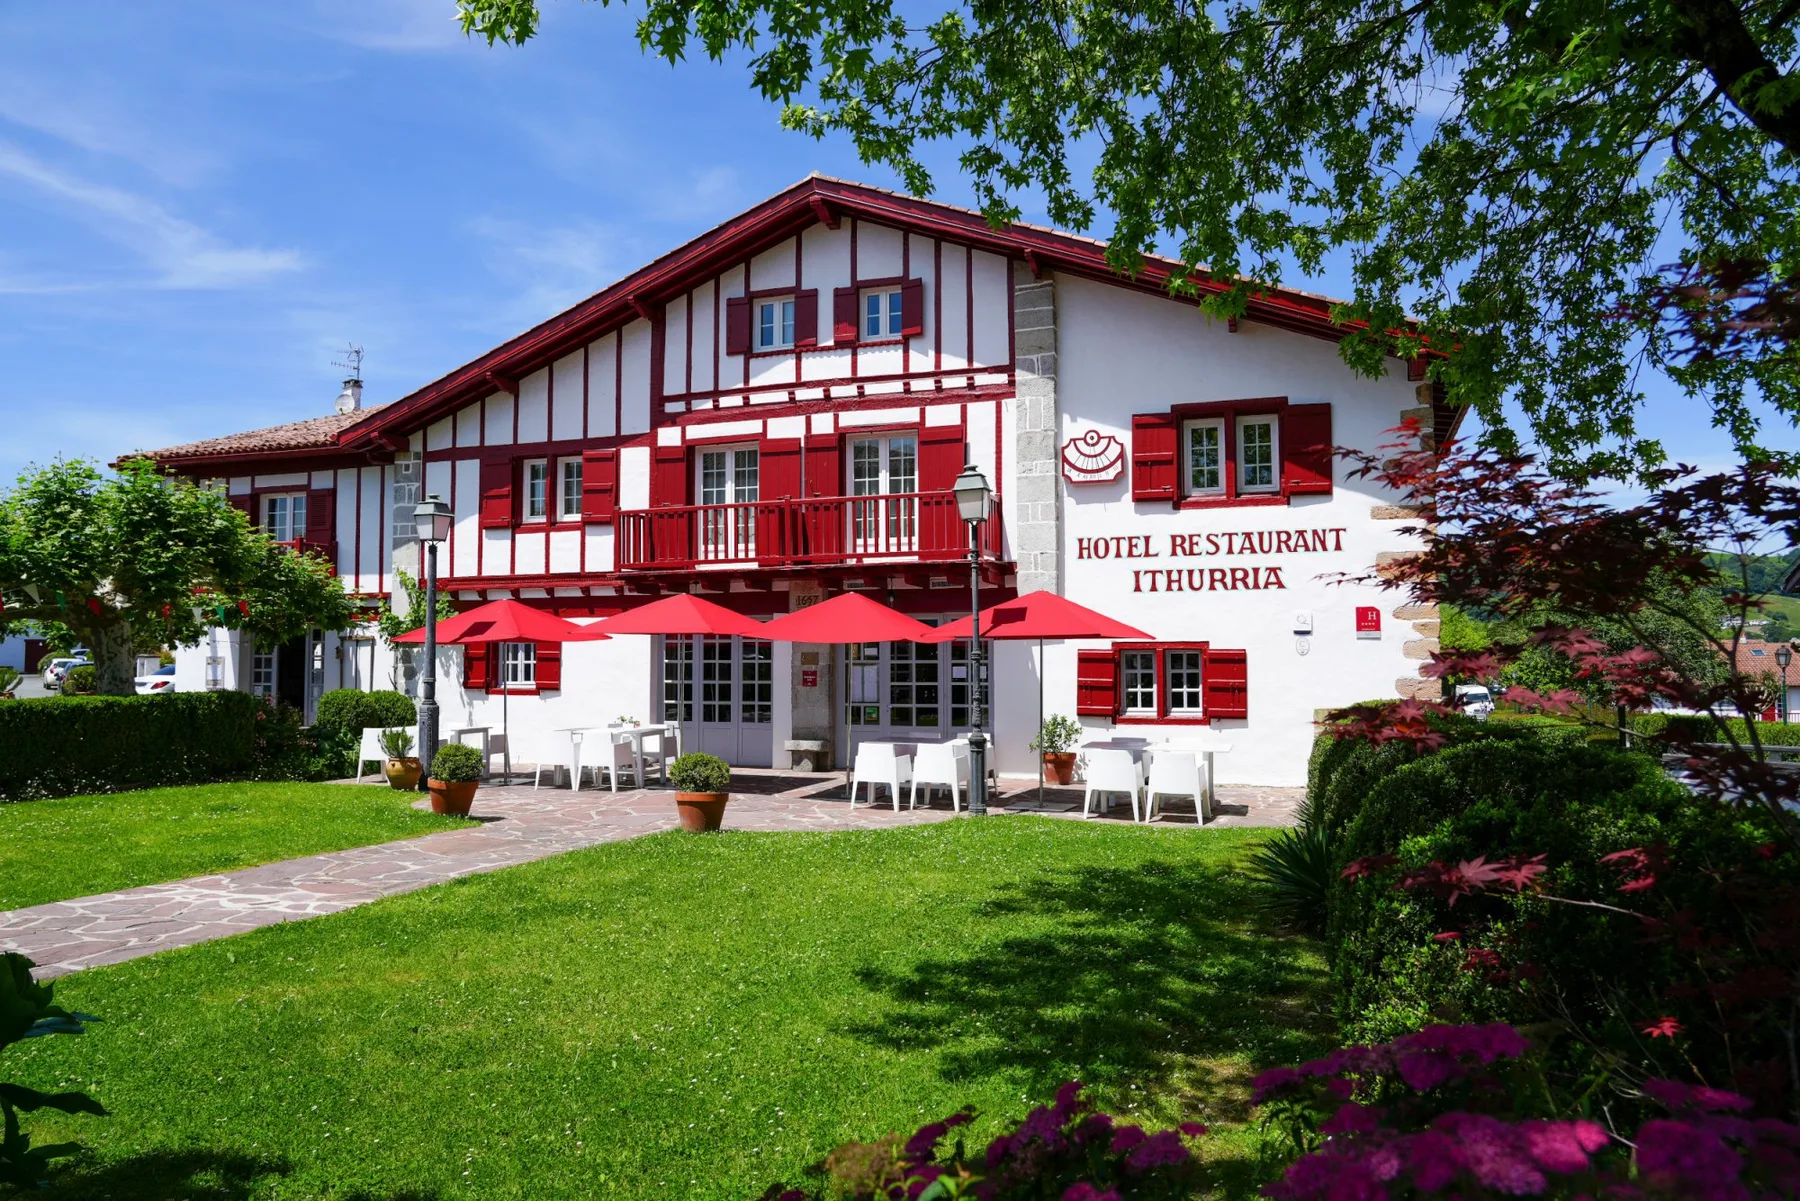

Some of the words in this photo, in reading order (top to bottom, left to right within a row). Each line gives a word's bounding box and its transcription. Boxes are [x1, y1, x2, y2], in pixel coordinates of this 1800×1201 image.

[1077, 535, 1160, 560] HOTEL
[1170, 528, 1347, 558] RESTAURANT
[1133, 567, 1286, 593] ITHURRIA
[1368, 611, 1377, 620] H
